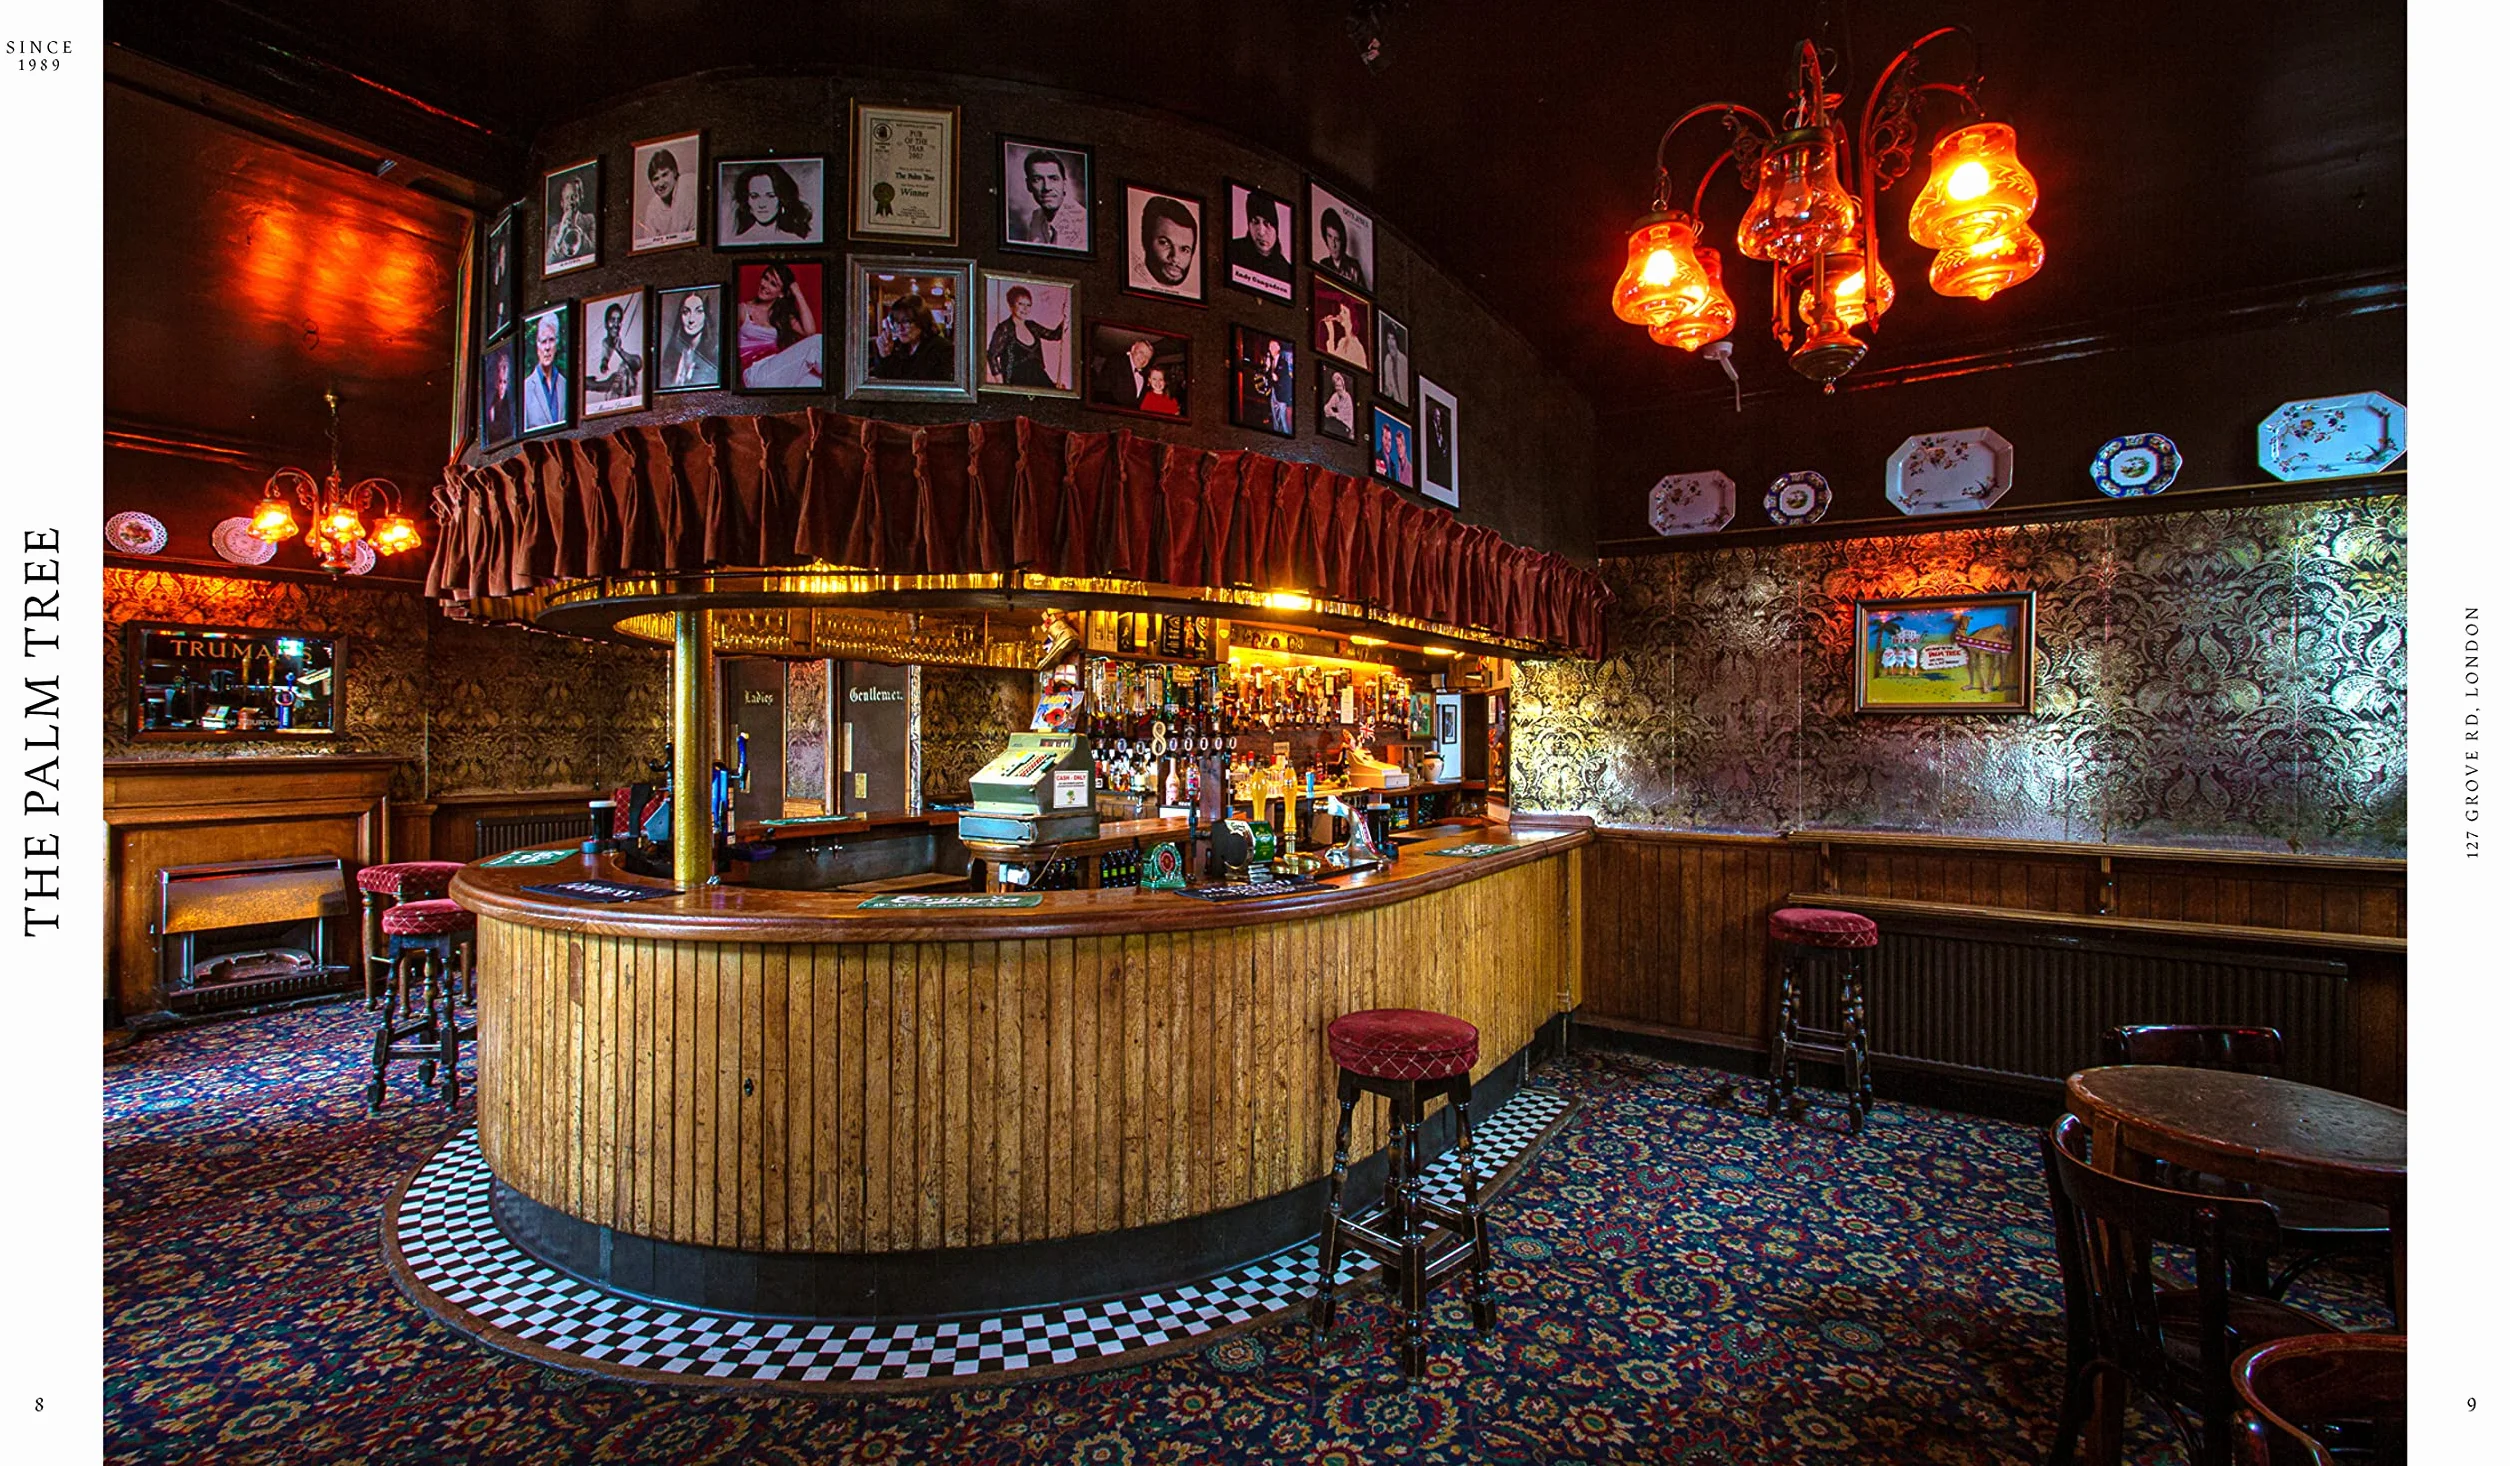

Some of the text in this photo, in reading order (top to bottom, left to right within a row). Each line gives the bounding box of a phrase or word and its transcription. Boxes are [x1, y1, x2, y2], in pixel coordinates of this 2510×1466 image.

[895, 171, 906, 179] The
[907, 172, 922, 180] Palm
[900, 187, 929, 197] Winner
[744, 689, 774, 706] Ladies
